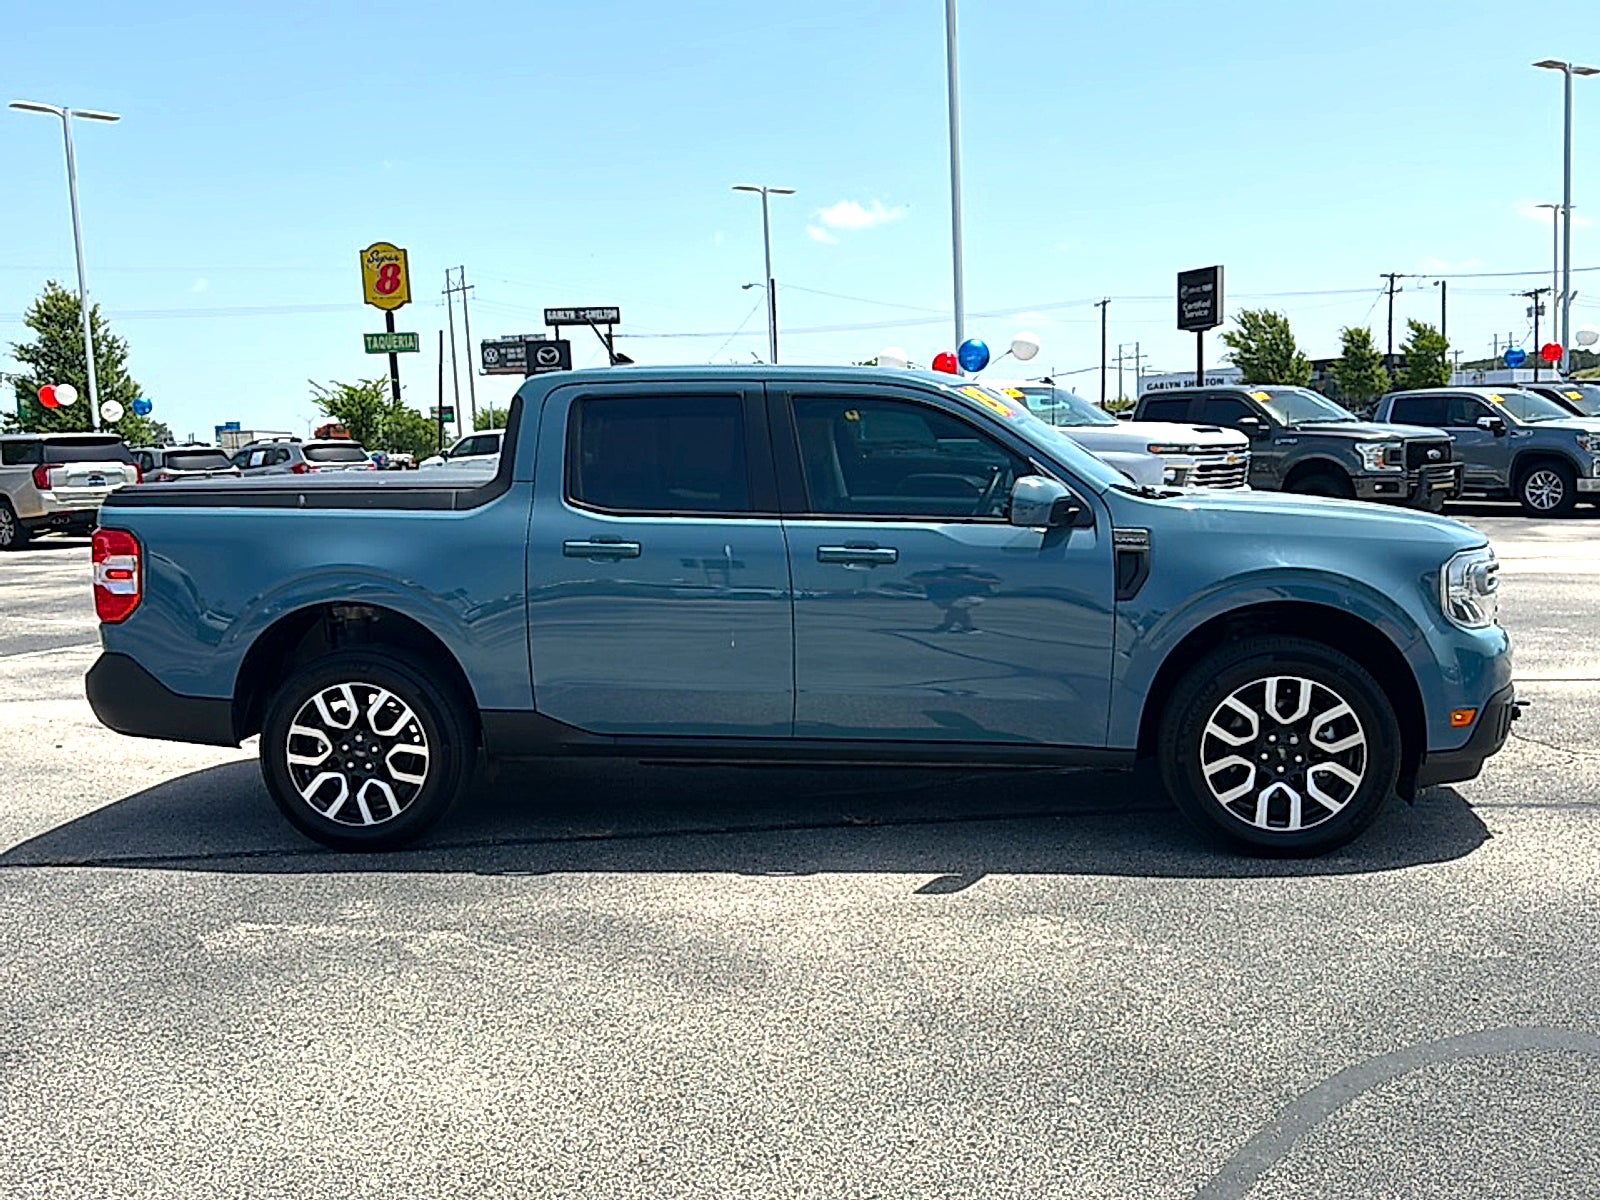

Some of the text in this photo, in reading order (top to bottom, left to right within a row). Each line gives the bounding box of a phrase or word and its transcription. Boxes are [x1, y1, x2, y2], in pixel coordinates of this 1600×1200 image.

[366, 249, 400, 268] Super
[375, 263, 401, 295] 8
[366, 335, 414, 350] TAQUERIA
[1147, 378, 1224, 390] GARLYN SHTON
